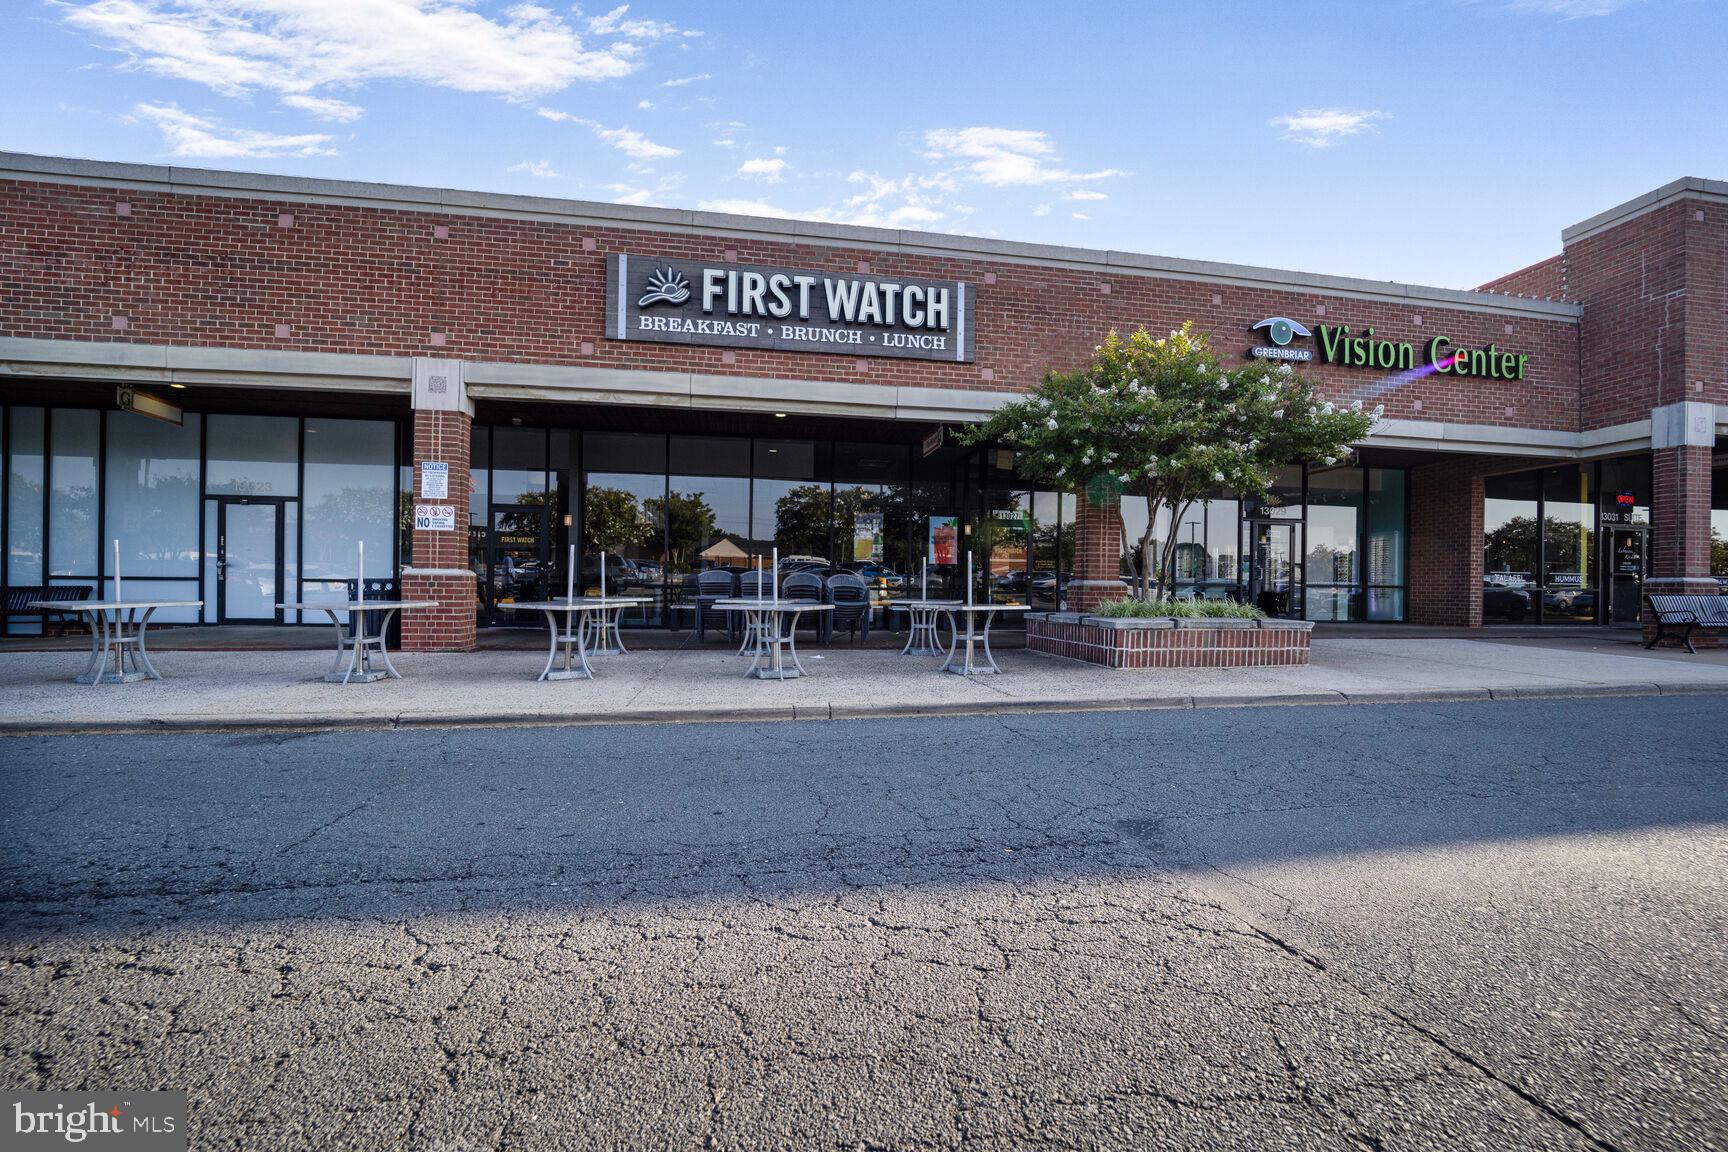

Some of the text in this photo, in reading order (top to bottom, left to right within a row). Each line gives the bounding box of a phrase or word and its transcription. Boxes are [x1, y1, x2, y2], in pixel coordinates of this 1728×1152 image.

[702, 268, 950, 330] FIRST WATCH
[639, 315, 947, 350] BREAKFAST BRUNCH LUNCH
[1255, 347, 1310, 360] GREENBRIAR
[1320, 324, 1528, 379] Vision Center
[1617, 495, 1635, 503] OPEN
[417, 517, 430, 528] NO
[517, 536, 535, 544] WATCH
[1555, 575, 1583, 583] HUMMUS
